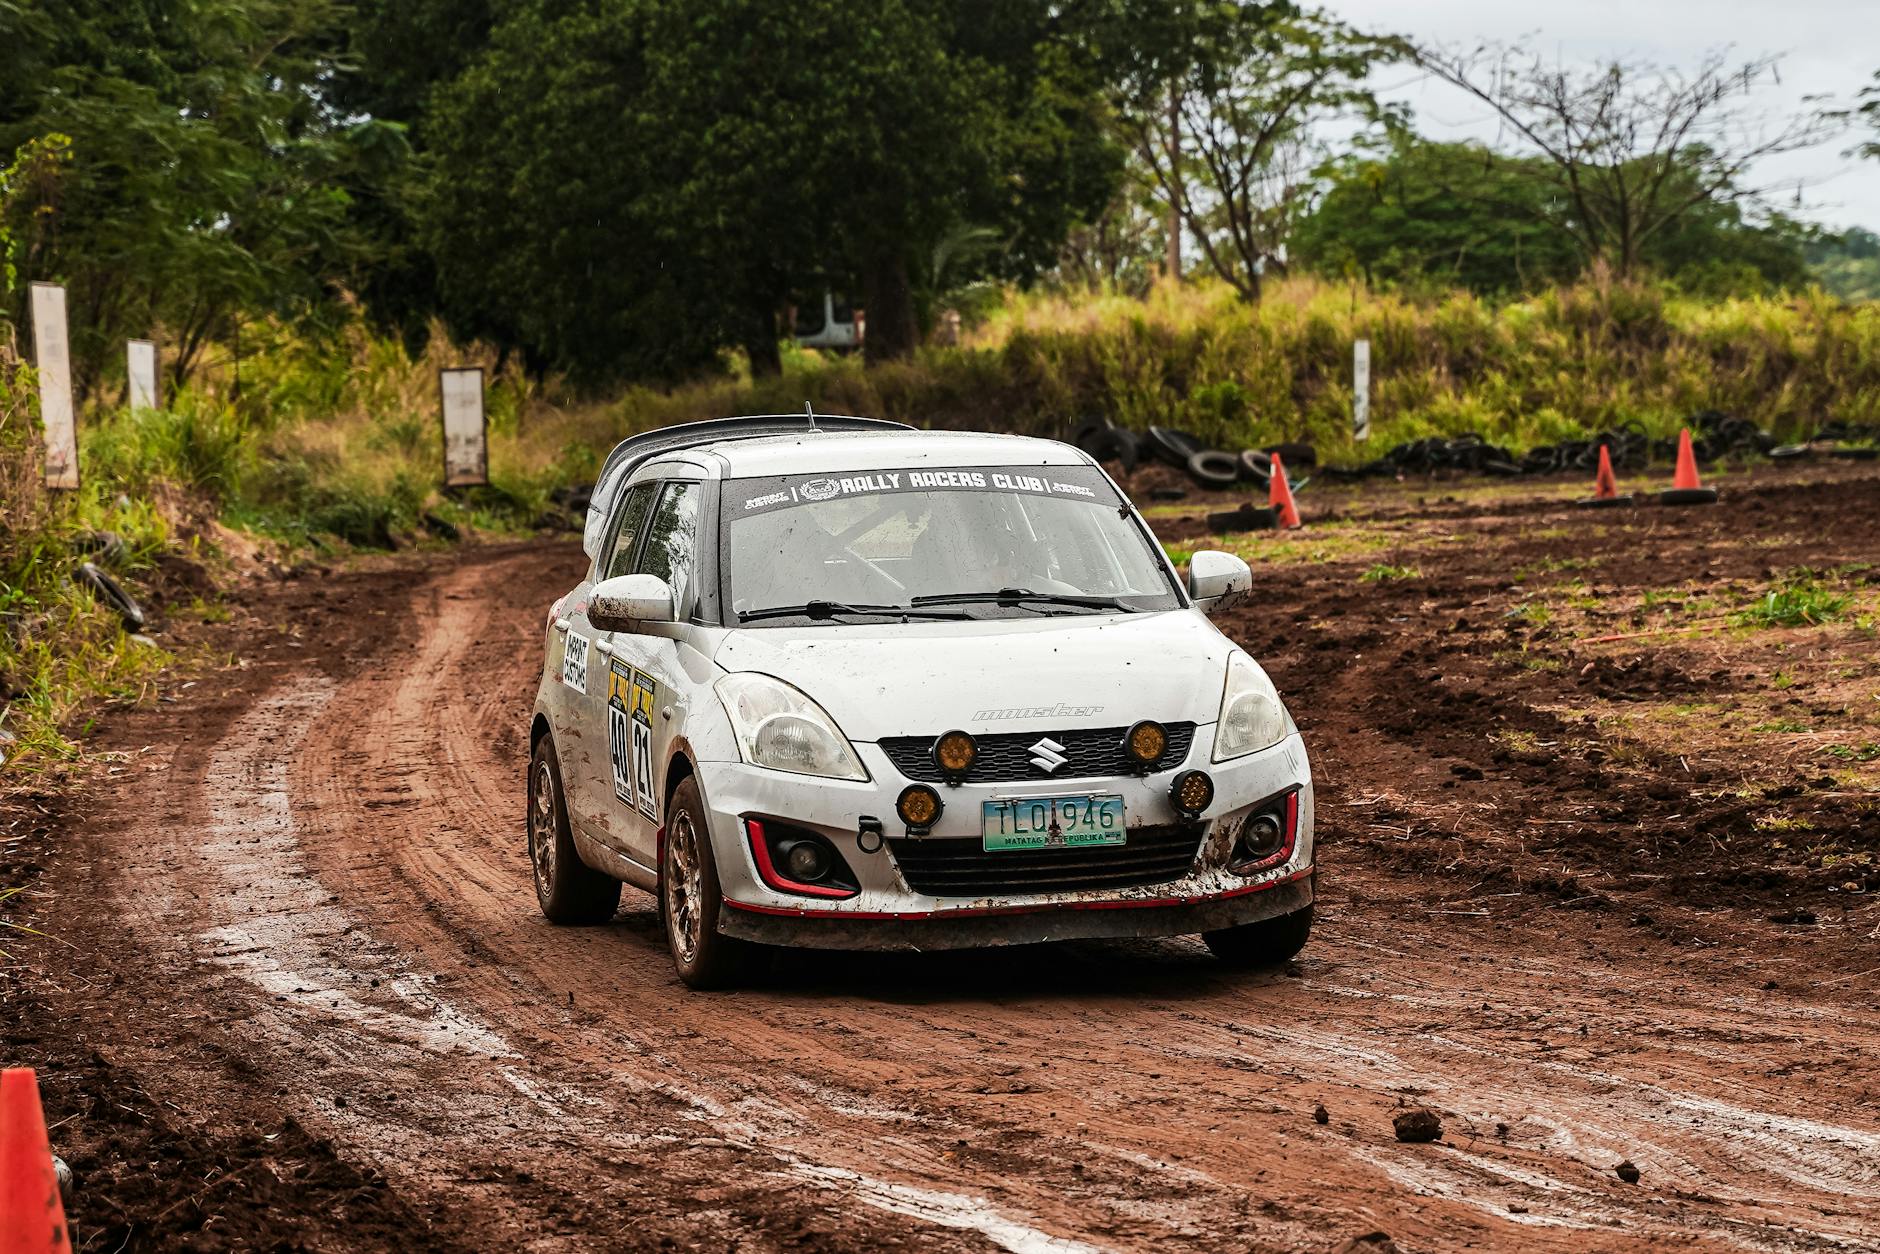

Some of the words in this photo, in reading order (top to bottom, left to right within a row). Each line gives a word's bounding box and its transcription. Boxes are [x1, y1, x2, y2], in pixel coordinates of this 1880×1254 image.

[840, 474, 900, 493] RALLY
[908, 472, 986, 491] RACERS
[992, 474, 1044, 492] CLUB
[972, 702, 1105, 722] monster
[611, 710, 628, 785] 40
[634, 723, 652, 800] 21
[1062, 801, 1114, 831] 946
